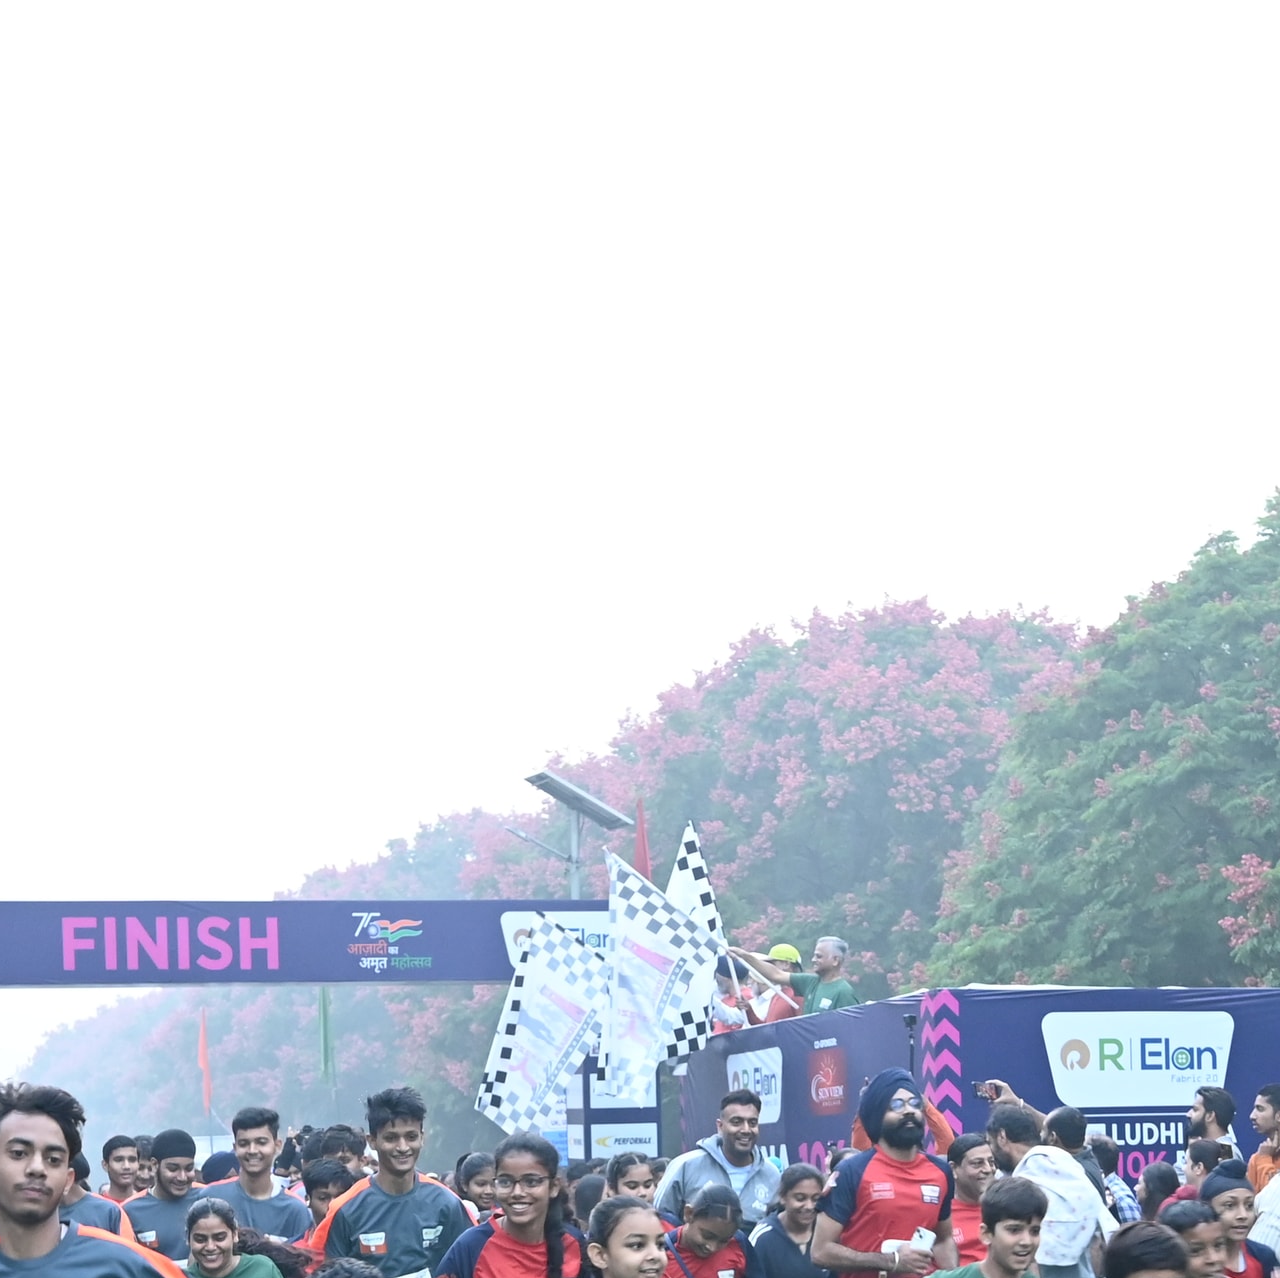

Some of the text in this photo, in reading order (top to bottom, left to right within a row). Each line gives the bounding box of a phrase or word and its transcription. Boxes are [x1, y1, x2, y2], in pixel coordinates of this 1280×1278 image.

[62, 916, 279, 971] FINISH
[388, 946, 399, 955] का
[359, 953, 432, 973] अमृत महोत्सव
[1099, 1038, 1217, 1071] R Elan
[754, 1067, 777, 1096] Elan
[1171, 1074, 1201, 1083] Fabric
[614, 1136, 651, 1145] PERFORMAX
[1111, 1122, 1237, 1145] LUDHI
